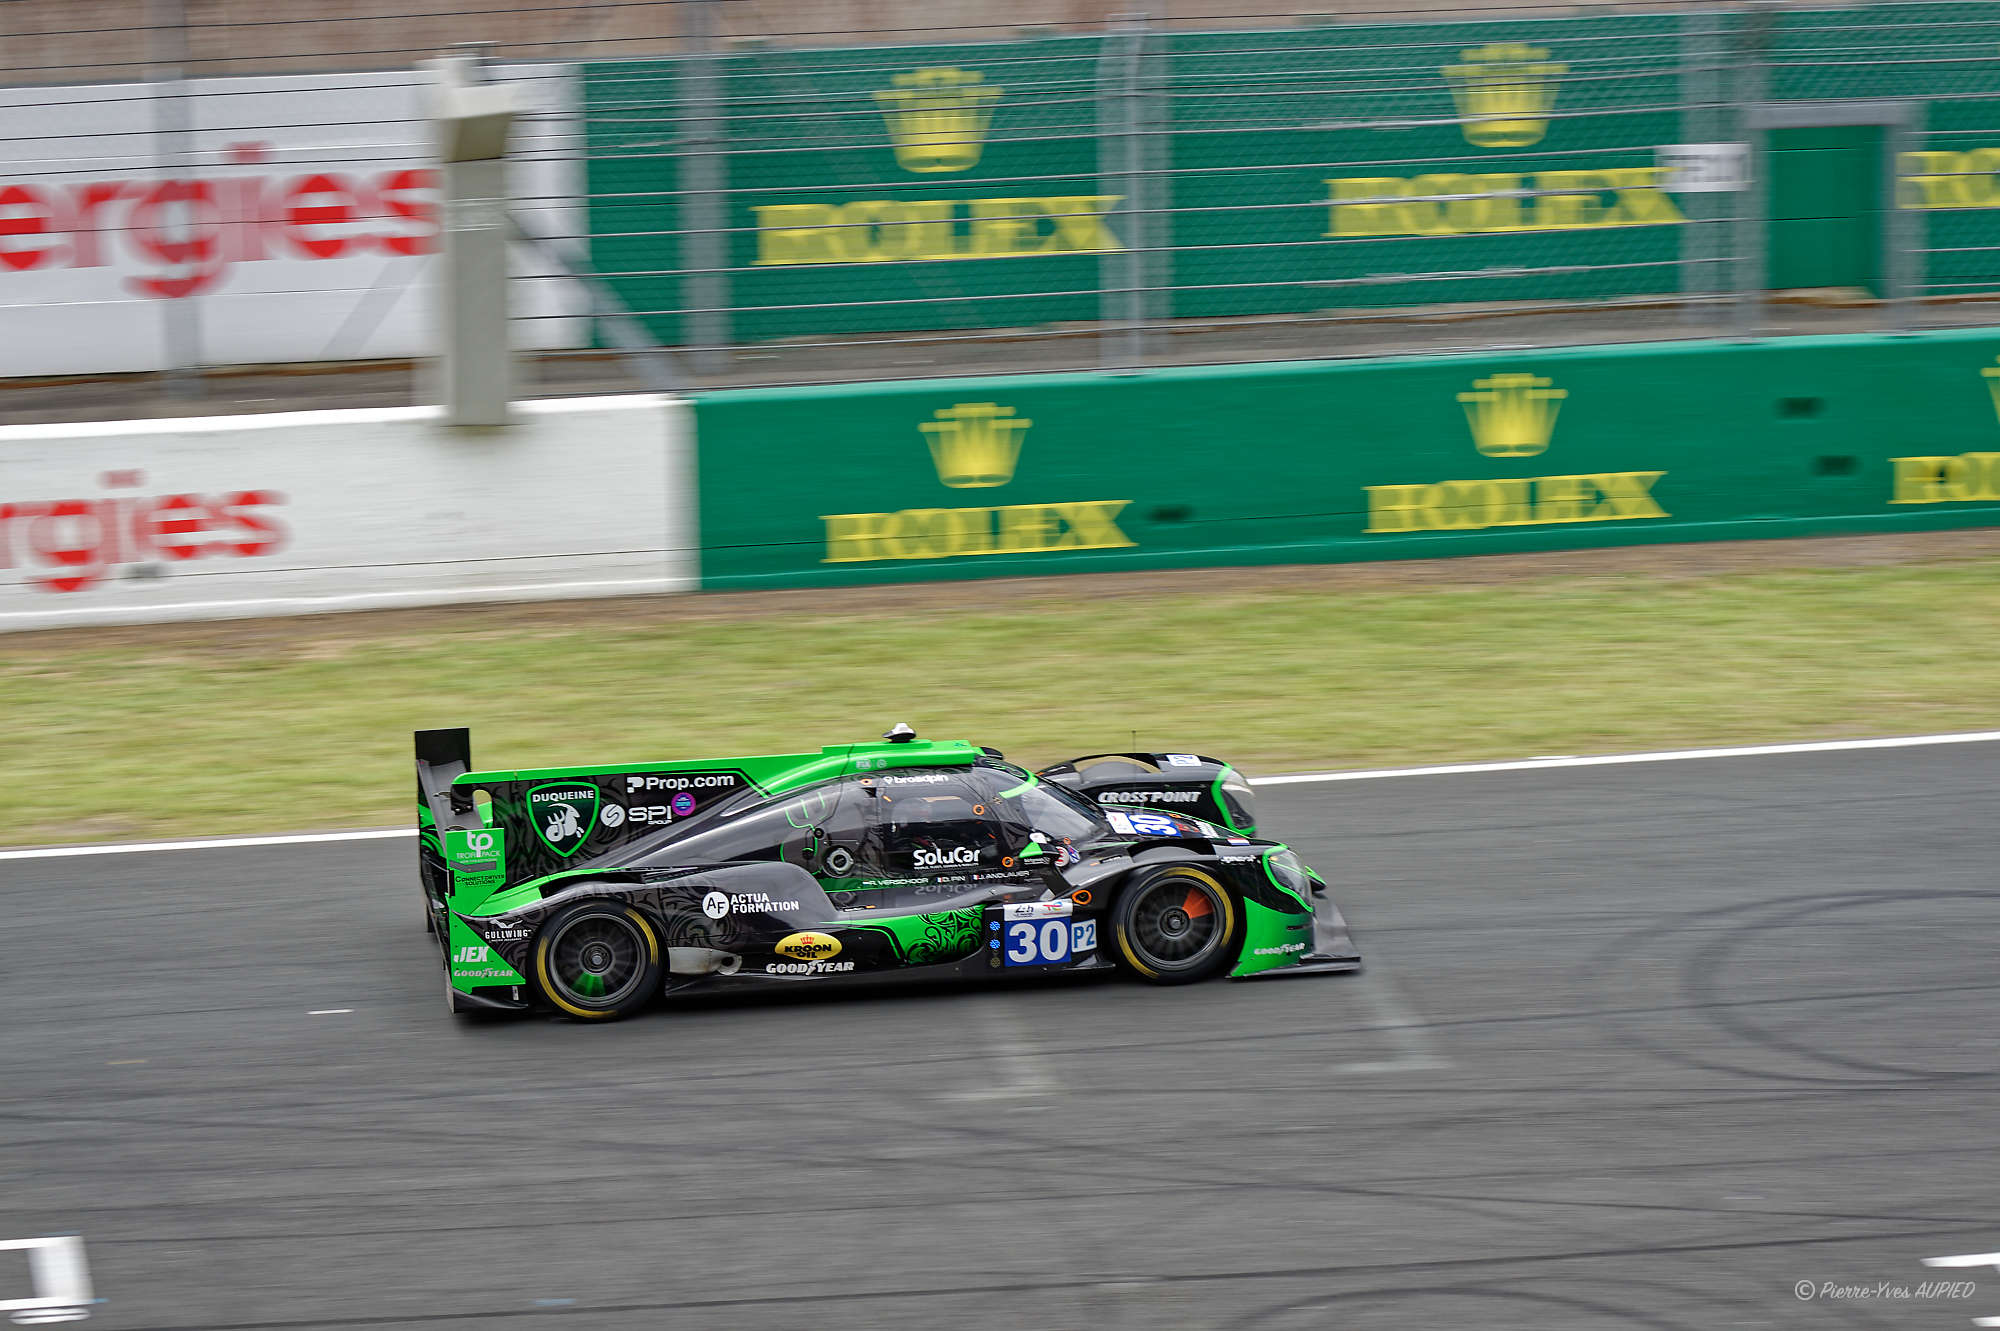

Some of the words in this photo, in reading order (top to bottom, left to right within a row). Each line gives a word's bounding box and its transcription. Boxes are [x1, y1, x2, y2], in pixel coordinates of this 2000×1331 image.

[749, 194, 1126, 266] ROLEX
[1361, 470, 1672, 534] ROLEX
[818, 499, 1139, 564] ROLEX
[645, 775, 735, 791] Prop.com
[532, 790, 595, 803] DUQUEINE
[1098, 791, 1149, 803] CROSS
[1150, 791, 1202, 803] POINT
[628, 805, 673, 822] SPI
[913, 846, 980, 866] SoluCar
[706, 897, 726, 914] AF
[730, 892, 770, 905] ACTUA
[732, 901, 799, 914] FORMATION
[484, 929, 529, 940] GULLWING
[1008, 920, 1069, 963] 30
[1073, 923, 1095, 949] P2
[453, 946, 490, 963] JEX
[784, 943, 832, 953] KROON
[797, 951, 818, 959] OIL
[454, 967, 514, 978] GOODYEAR
[765, 959, 855, 976] GOODYEAR
